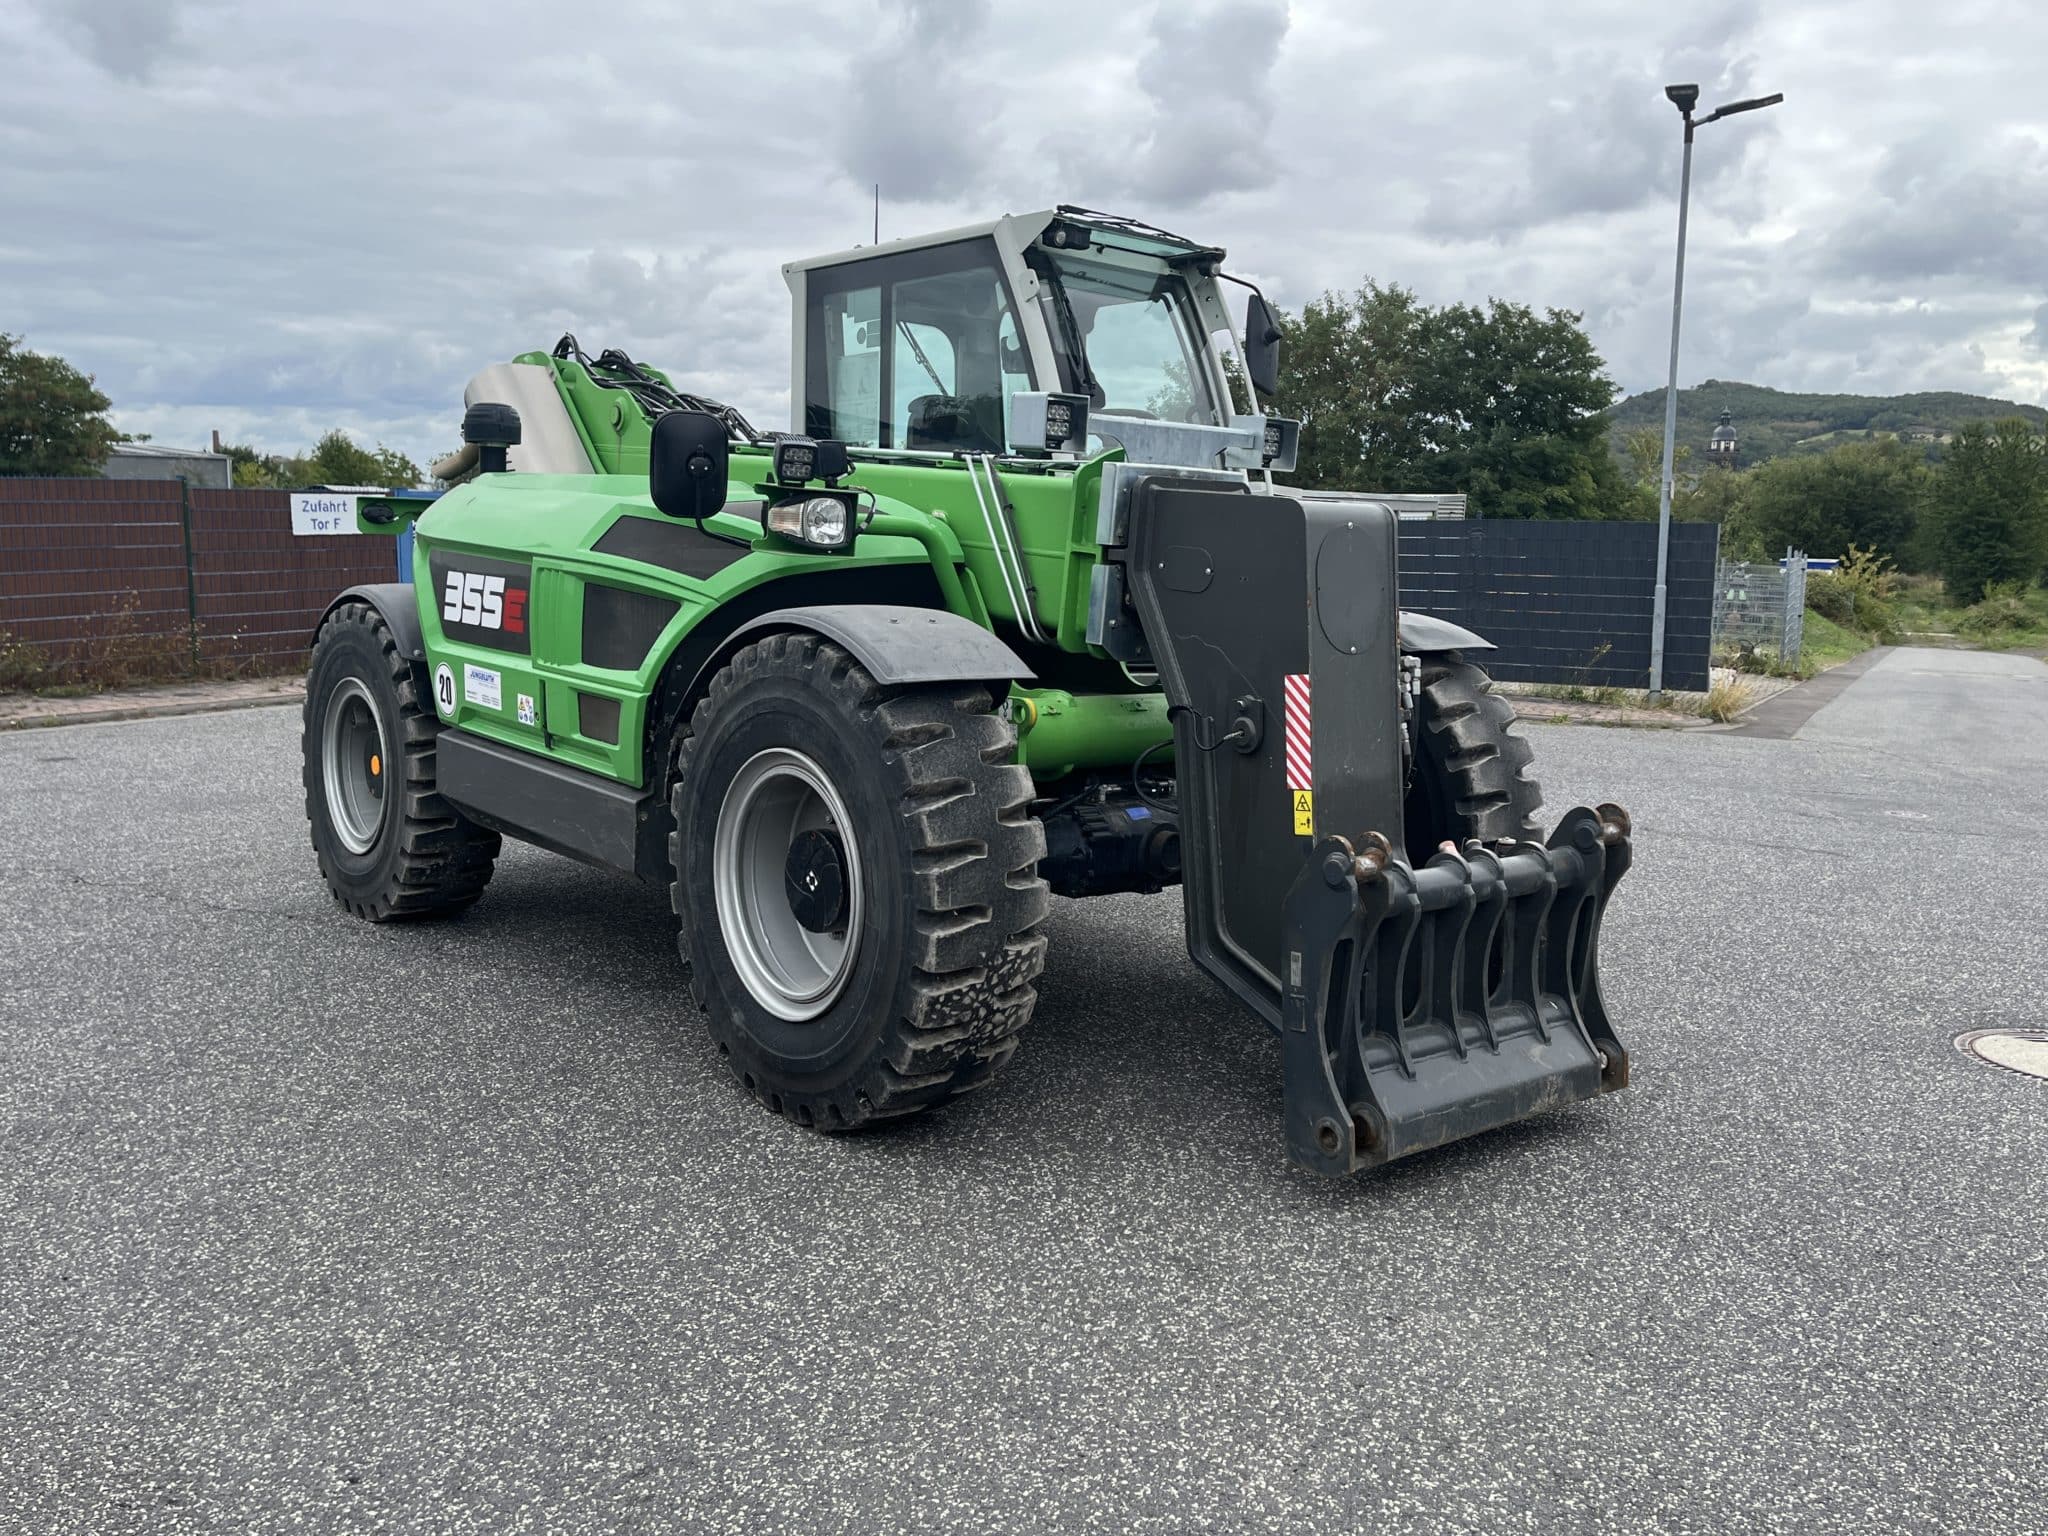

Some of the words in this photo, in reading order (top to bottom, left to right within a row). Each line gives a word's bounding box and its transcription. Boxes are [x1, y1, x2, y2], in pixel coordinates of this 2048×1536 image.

[302, 500, 348, 513] Zufahrt
[310, 518, 330, 530] Tor
[334, 518, 341, 530] F
[439, 674, 452, 705] 20
